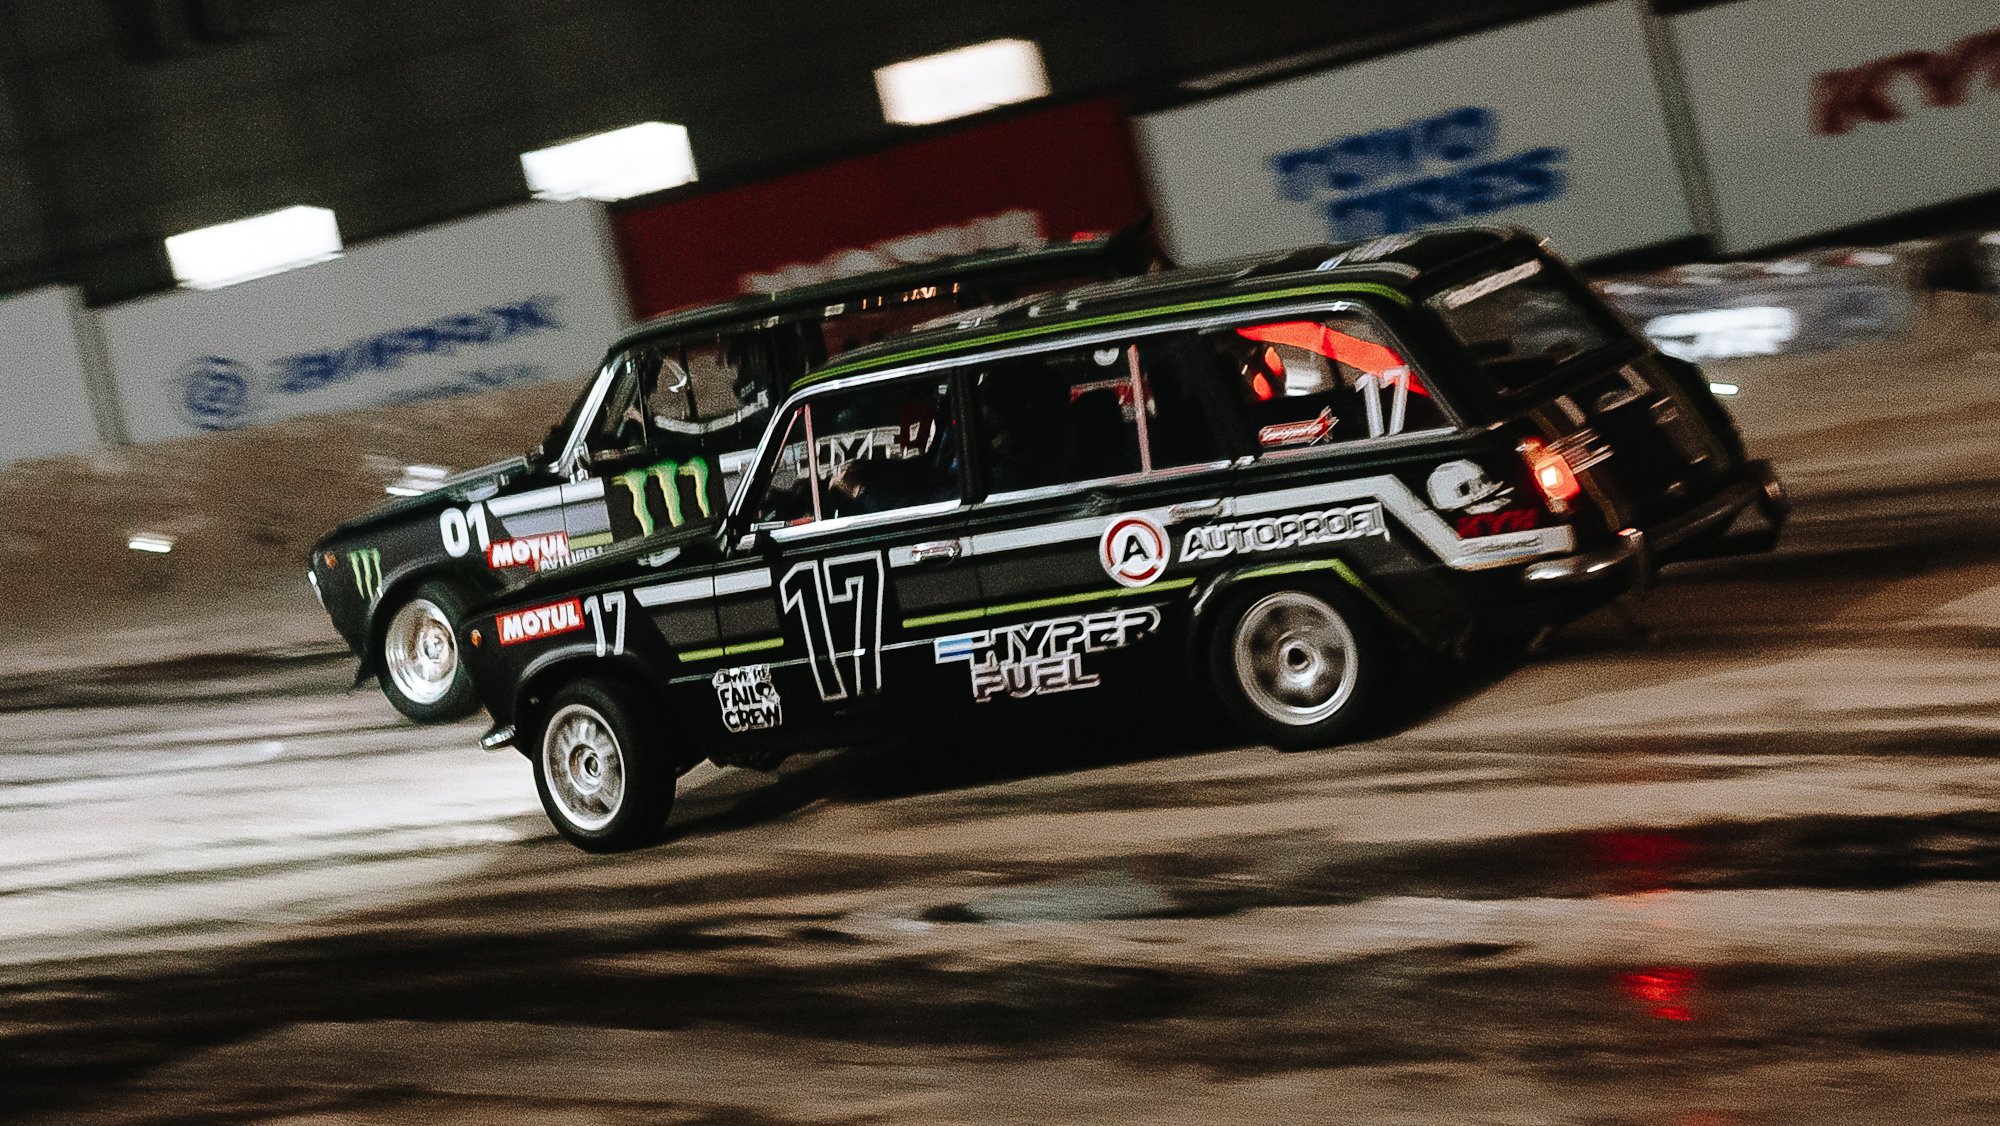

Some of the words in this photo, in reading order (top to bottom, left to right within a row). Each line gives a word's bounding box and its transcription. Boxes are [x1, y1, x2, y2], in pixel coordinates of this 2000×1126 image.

[1808, 28, 2000, 136] KY
[1355, 364, 1411, 438] 17
[440, 501, 492, 558] 01
[491, 532, 568, 569] MOTUL
[1179, 502, 1390, 563] AUTOPROFI
[502, 602, 580, 642] MOTUL
[584, 591, 627, 657] 17
[779, 550, 885, 701] 17
[940, 606, 1161, 672] HYPER
[972, 653, 1101, 702] FUEL
[723, 703, 782, 730] CREW
